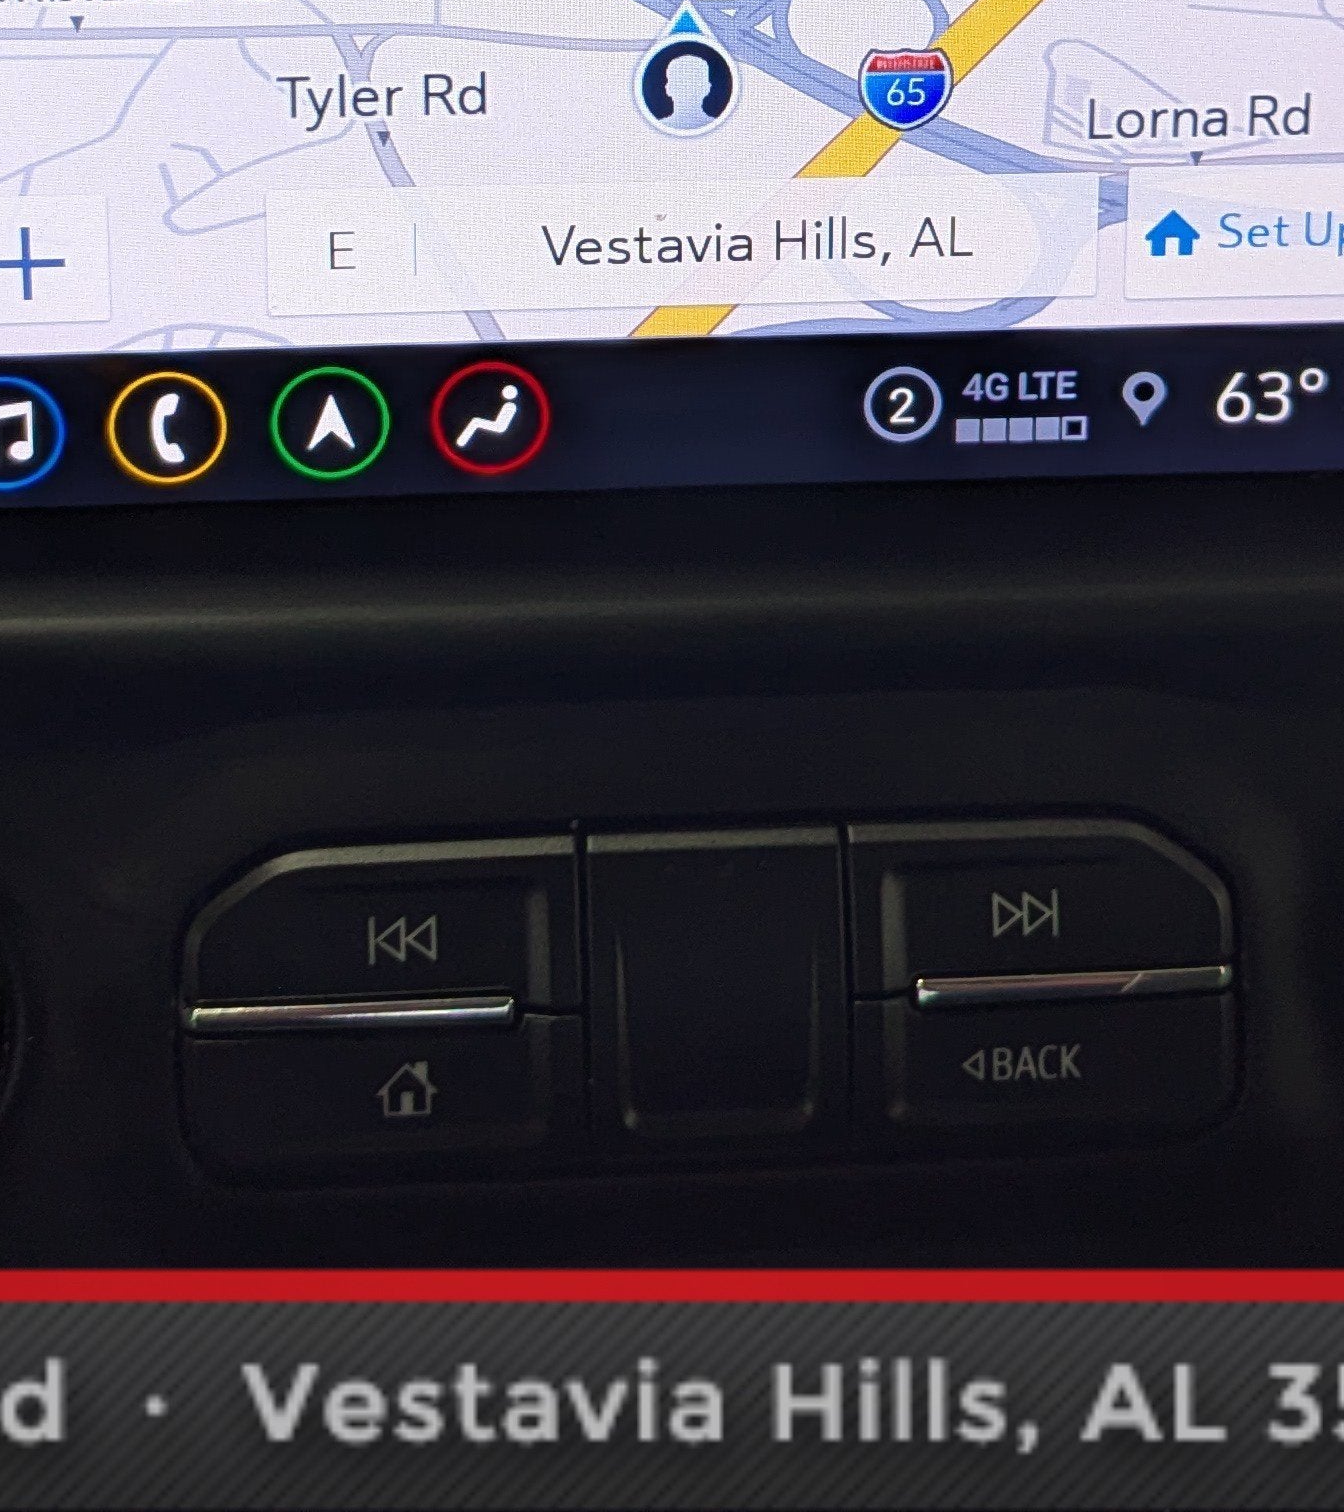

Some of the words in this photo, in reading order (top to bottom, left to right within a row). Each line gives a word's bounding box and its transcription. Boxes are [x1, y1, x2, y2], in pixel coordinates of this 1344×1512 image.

[276, 74, 406, 131] Tyler
[423, 72, 488, 116] Rd
[886, 77, 926, 107] 65
[1087, 96, 1229, 140] Lorna
[1247, 92, 1313, 137] Rd
[541, 223, 753, 266] Vestavia
[774, 215, 892, 266] Hills,
[908, 215, 974, 258] AL
[1217, 213, 1290, 248] Set
[328, 230, 357, 271] E
[961, 371, 1010, 402] 4G
[1017, 369, 1079, 401] LTE
[888, 386, 916, 424] 2
[992, 1043, 1082, 1081] BACK
